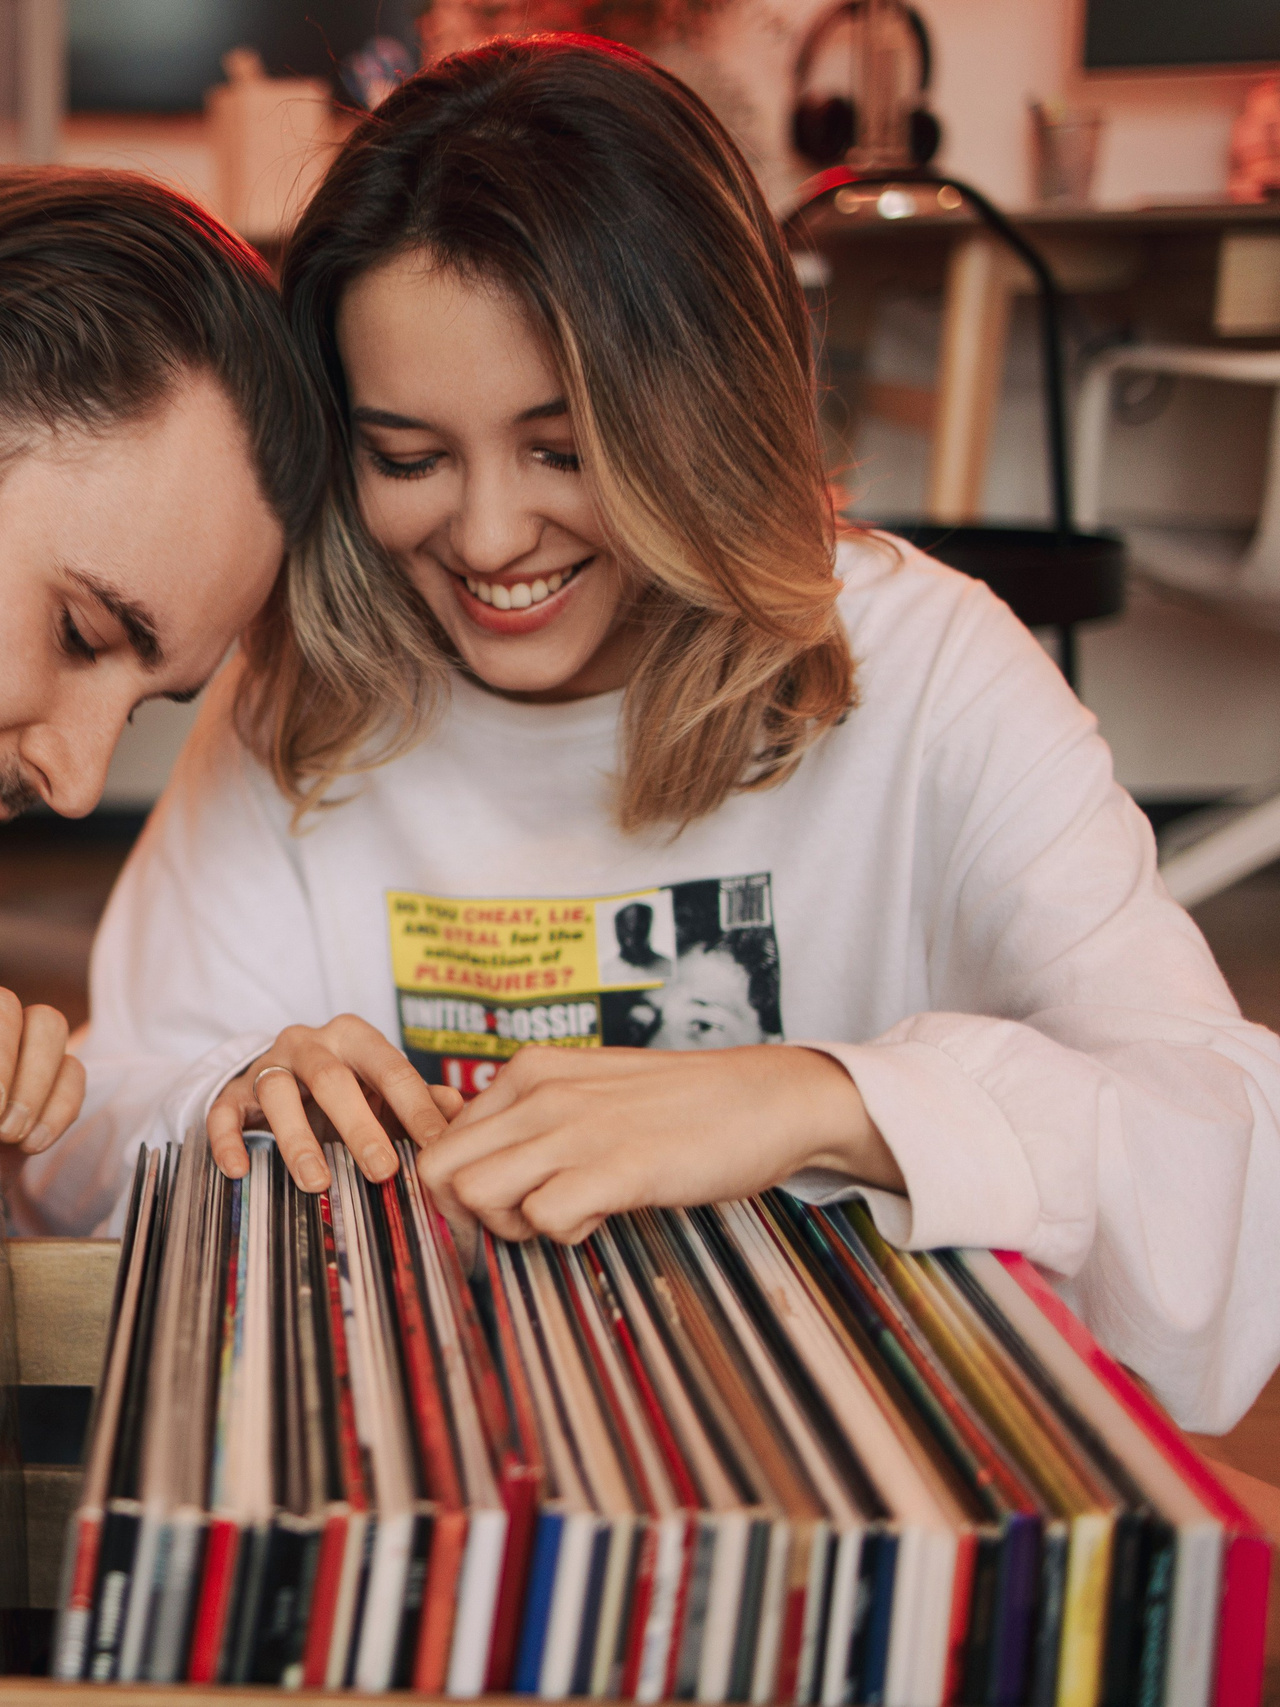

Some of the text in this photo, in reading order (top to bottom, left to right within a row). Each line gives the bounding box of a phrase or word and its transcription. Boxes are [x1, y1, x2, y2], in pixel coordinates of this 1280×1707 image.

[462, 908, 541, 927] CHEAT,
[443, 925, 500, 946] STEAL
[510, 930, 541, 946] for
[548, 928, 584, 943] the
[424, 947, 562, 966] satisfaction of
[415, 964, 574, 992] PLEASURES?
[496, 1002, 597, 1040] GOSSIP
